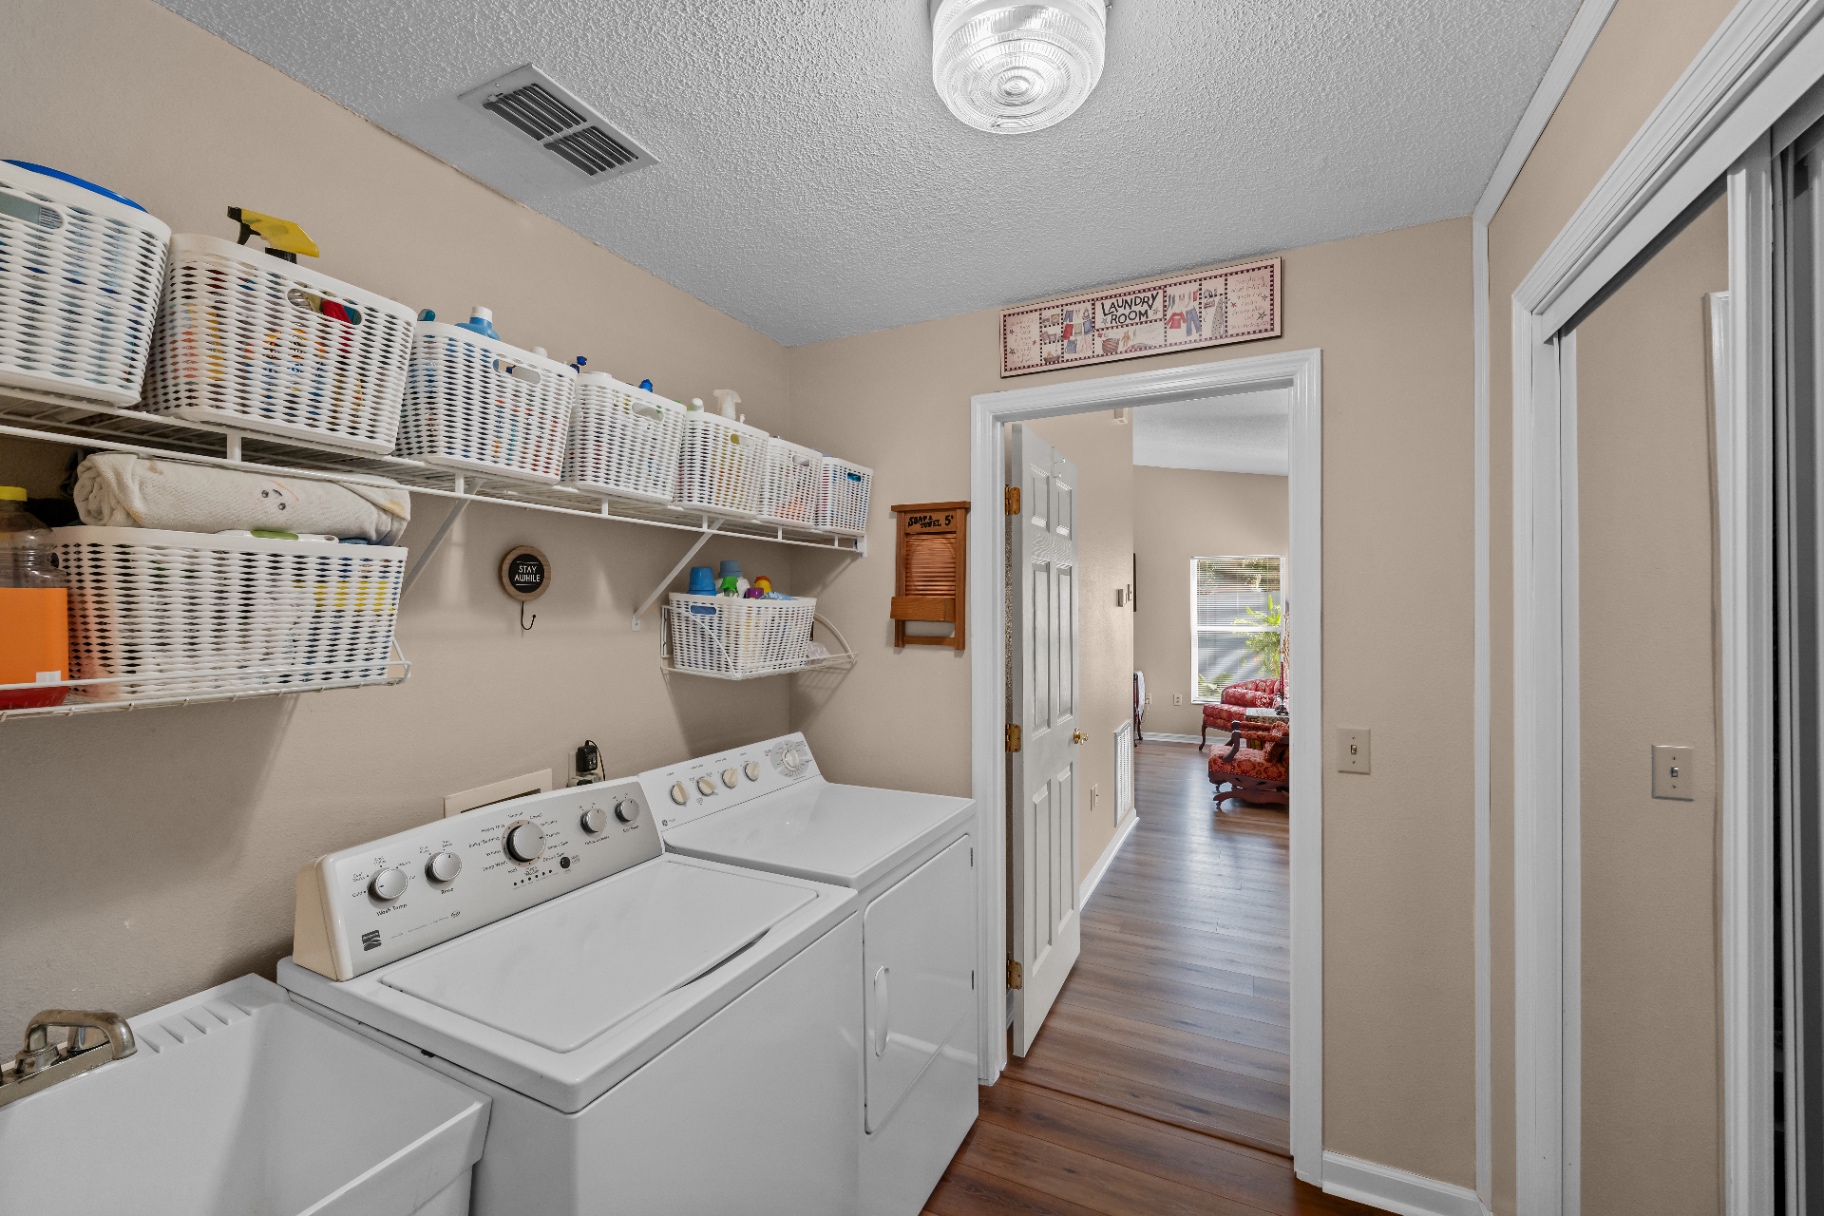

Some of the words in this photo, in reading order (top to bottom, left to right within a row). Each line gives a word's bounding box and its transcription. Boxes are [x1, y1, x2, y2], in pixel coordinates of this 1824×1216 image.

[1100, 291, 1160, 317] LAUNDRY
[1110, 309, 1149, 324] ROOM
[907, 515, 928, 528] SOAP
[920, 519, 942, 529] TOWEL
[518, 565, 538, 574] STAY
[514, 574, 541, 583] AWHILE
